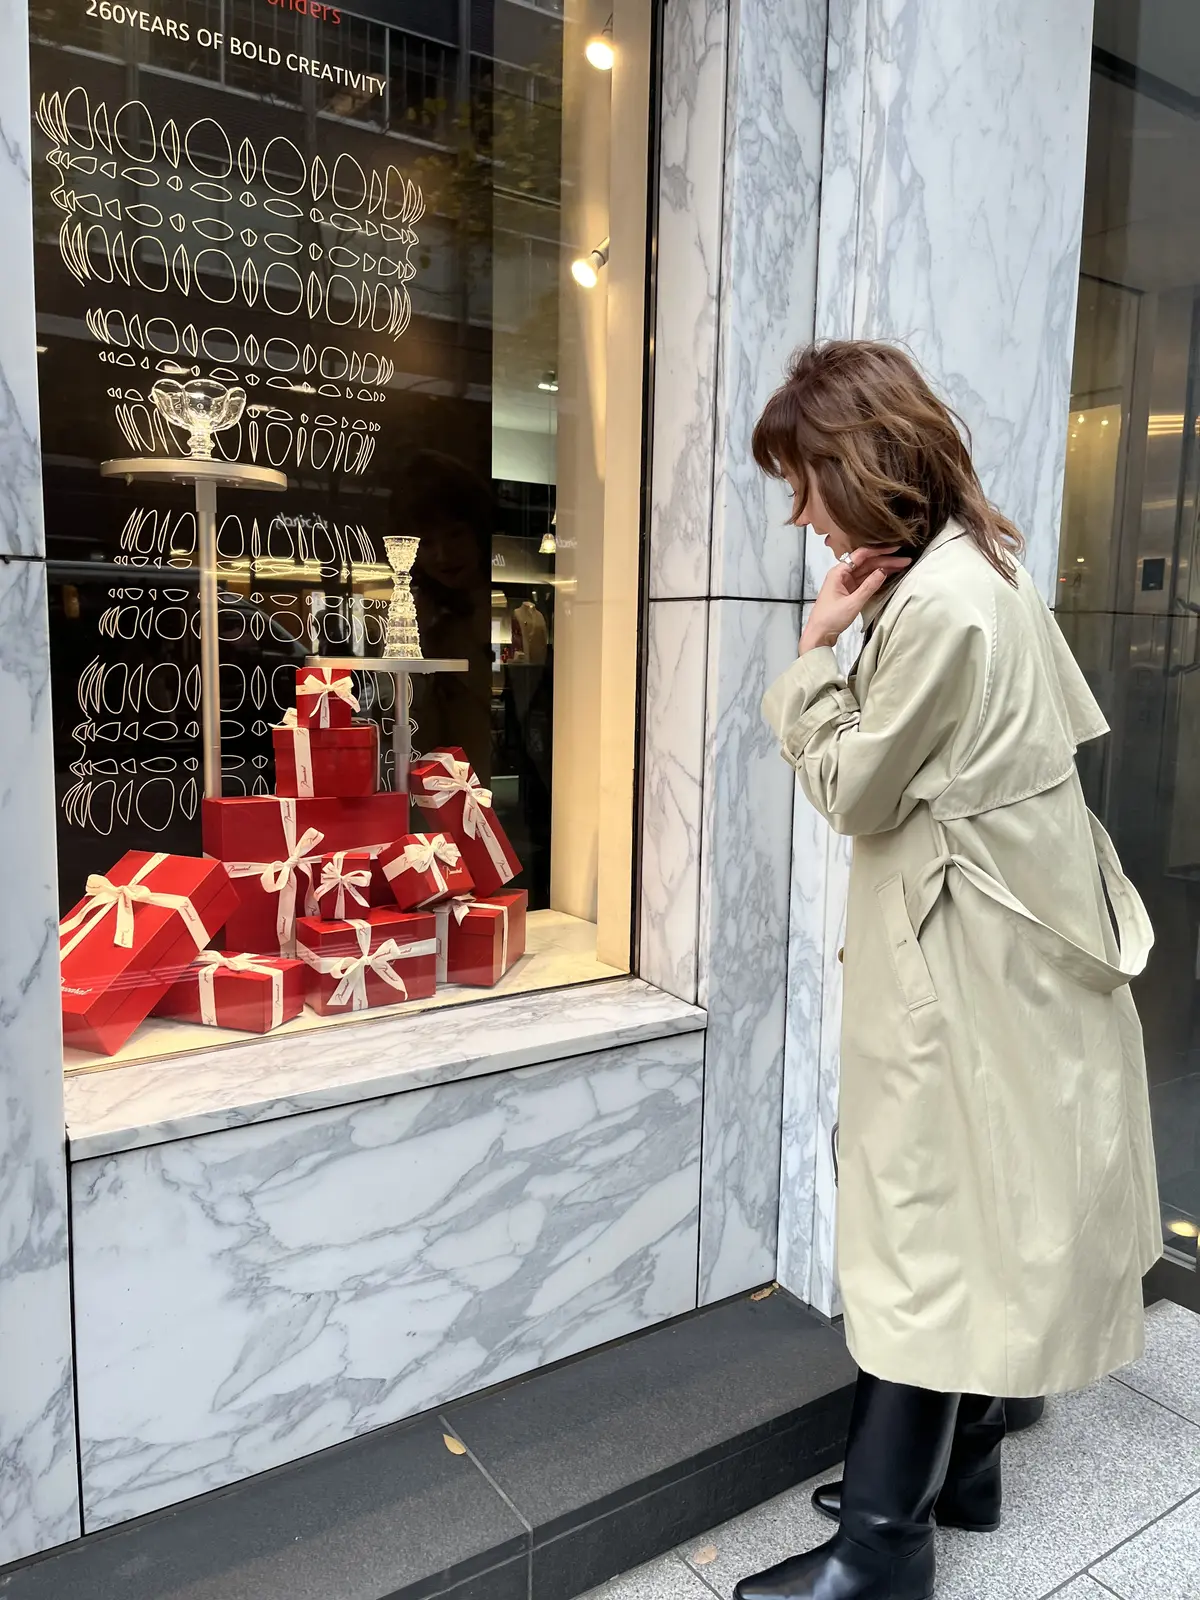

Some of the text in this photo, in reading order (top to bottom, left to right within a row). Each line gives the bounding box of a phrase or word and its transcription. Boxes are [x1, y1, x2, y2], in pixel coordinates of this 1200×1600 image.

[267, 0, 341, 25] nders
[85, 0, 387, 97] 260YEARS OF BOLD CREATIVITY
